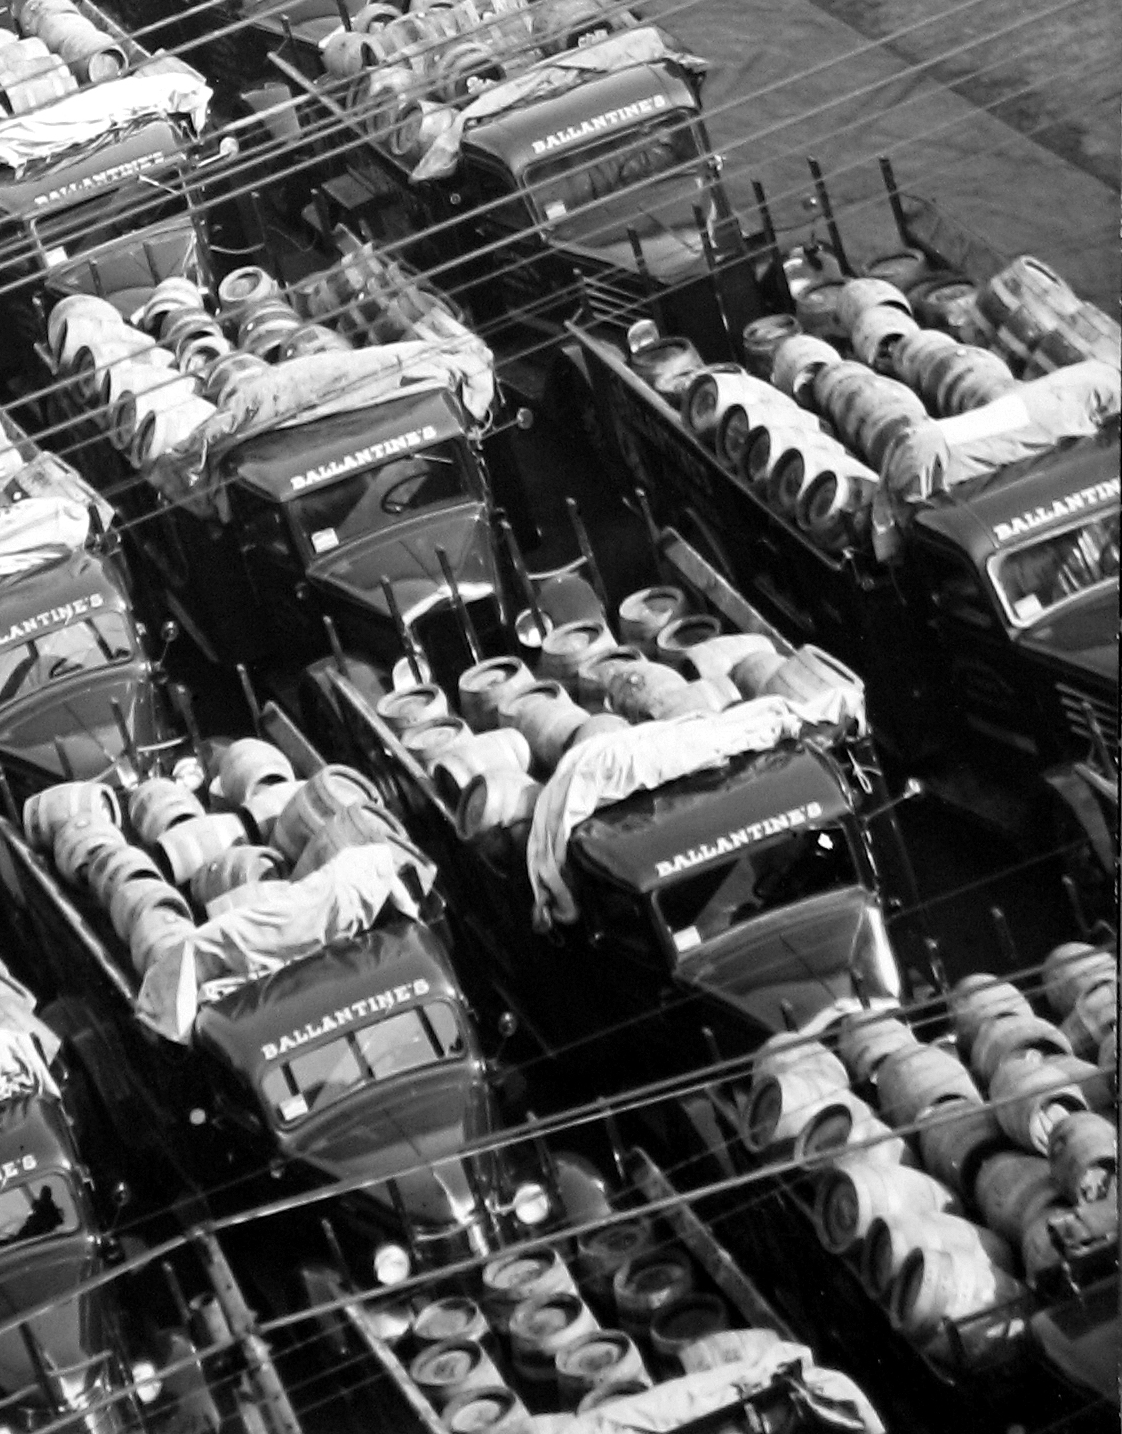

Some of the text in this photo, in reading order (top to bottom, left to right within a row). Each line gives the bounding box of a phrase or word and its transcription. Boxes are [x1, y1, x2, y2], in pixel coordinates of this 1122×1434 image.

[531, 95, 667, 155] BALLANTINE'S
[291, 425, 437, 490] BALLANTINE'S
[655, 802, 823, 877] BALLANTINE'S
[261, 978, 431, 1061] BALLANTINE'S
